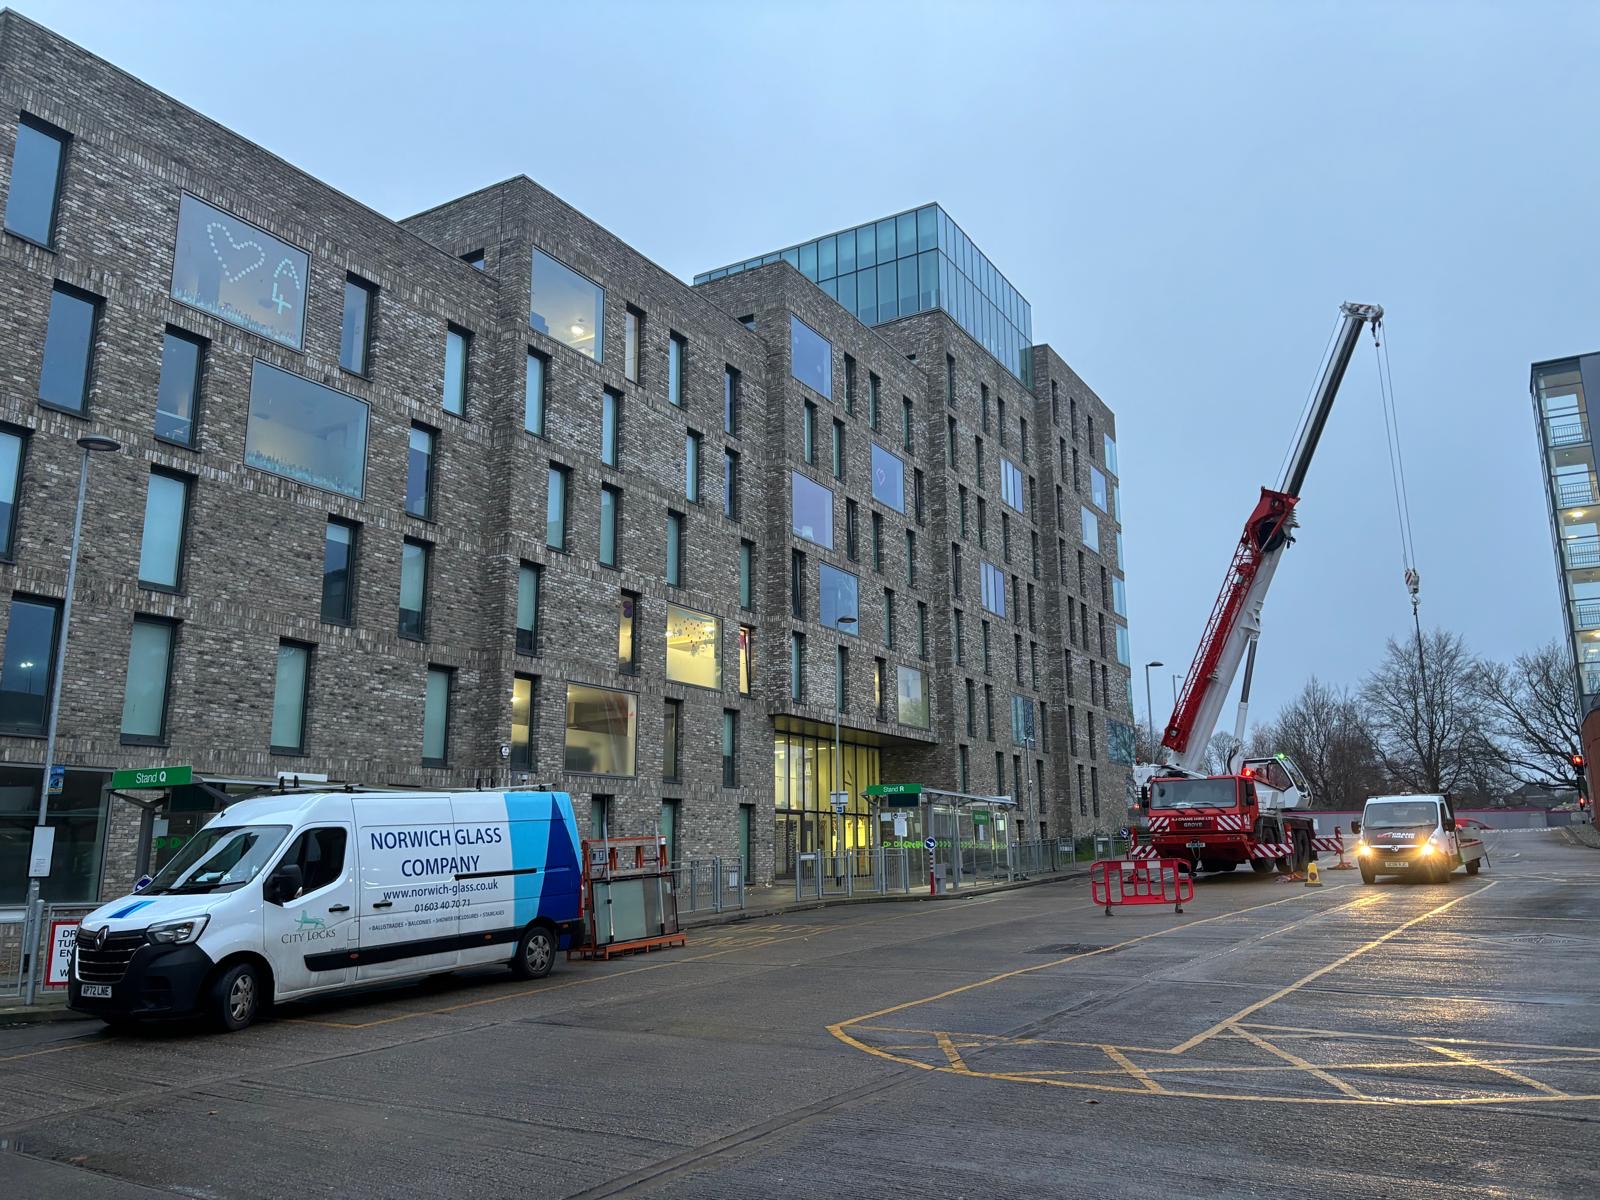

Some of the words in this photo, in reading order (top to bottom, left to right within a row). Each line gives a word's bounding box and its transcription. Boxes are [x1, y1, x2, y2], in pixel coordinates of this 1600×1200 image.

[135, 772, 158, 784] Stand
[159, 771, 167, 782] Q
[371, 829, 451, 850] NORWICH
[455, 827, 502, 845] GLASS
[401, 855, 480, 877] COMPANY
[383, 878, 498, 900] www.norwich-glass.co.uk
[414, 902, 438, 913] 01603
[440, 901, 450, 910] 40
[451, 900, 461, 909] 70
[462, 899, 471, 908] 71
[408, 919, 432, 927] BALCONIES
[482, 910, 505, 918] STAIRCASES
[281, 933, 305, 944] CITY
[307, 929, 336, 941] LOCKS
